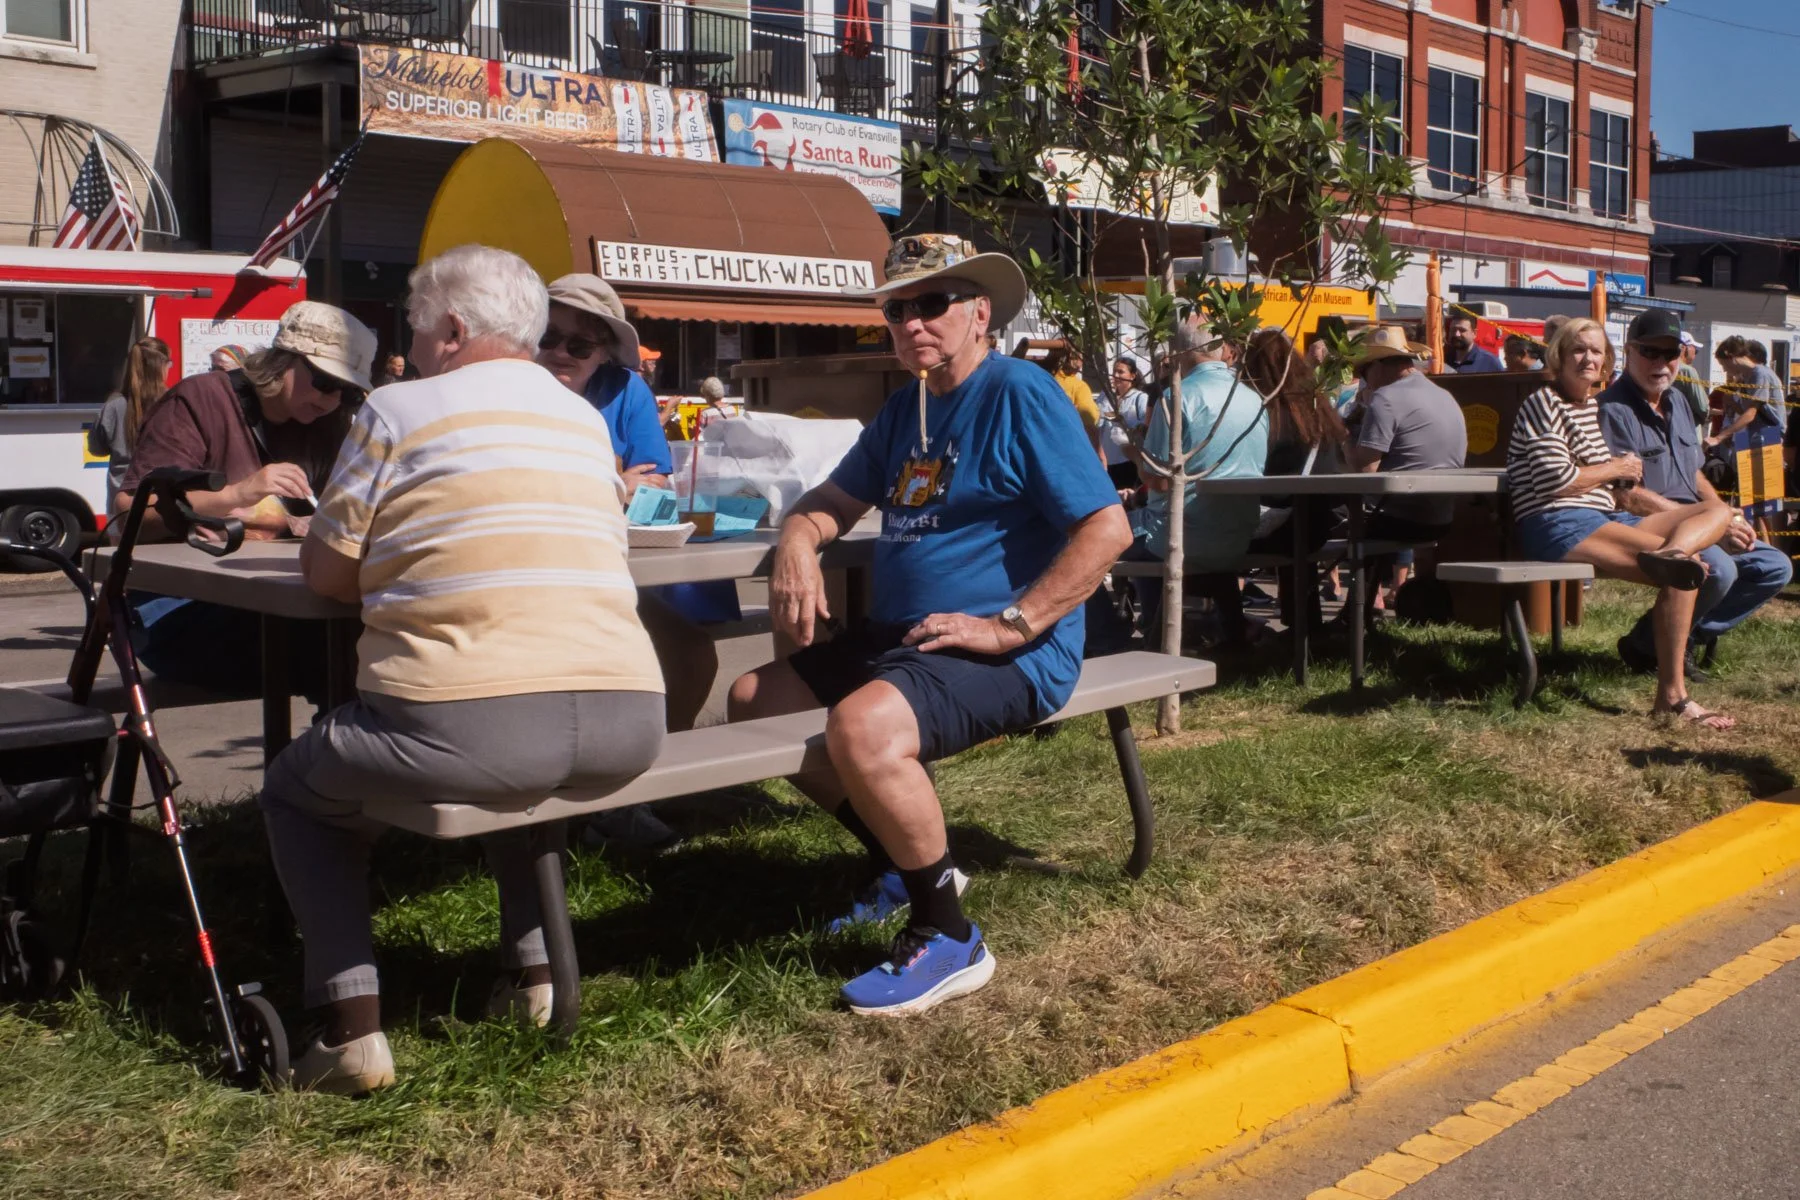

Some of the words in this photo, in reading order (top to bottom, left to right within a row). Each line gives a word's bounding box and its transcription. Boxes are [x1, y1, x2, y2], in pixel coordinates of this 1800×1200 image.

[367, 49, 484, 90] Michelob
[505, 70, 606, 107] ULTRA
[385, 91, 481, 119] SUPERIOR
[486, 103, 540, 127] LIGHT
[544, 111, 589, 131] BEER
[653, 89, 665, 132] ULTRA
[625, 109, 636, 153] ULTRA
[689, 116, 703, 158] ULTRA
[792, 117, 822, 135] Rotary
[825, 122, 845, 137] Club
[848, 126, 858, 138] of
[858, 127, 898, 145] Evansville
[802, 138, 854, 165] Santa
[858, 147, 892, 170] Run
[604, 261, 691, 281] CHRISTI
[694, 254, 868, 288] CHUCK-WAGON
[1263, 288, 1288, 302] African
[1324, 292, 1353, 305] Museum
